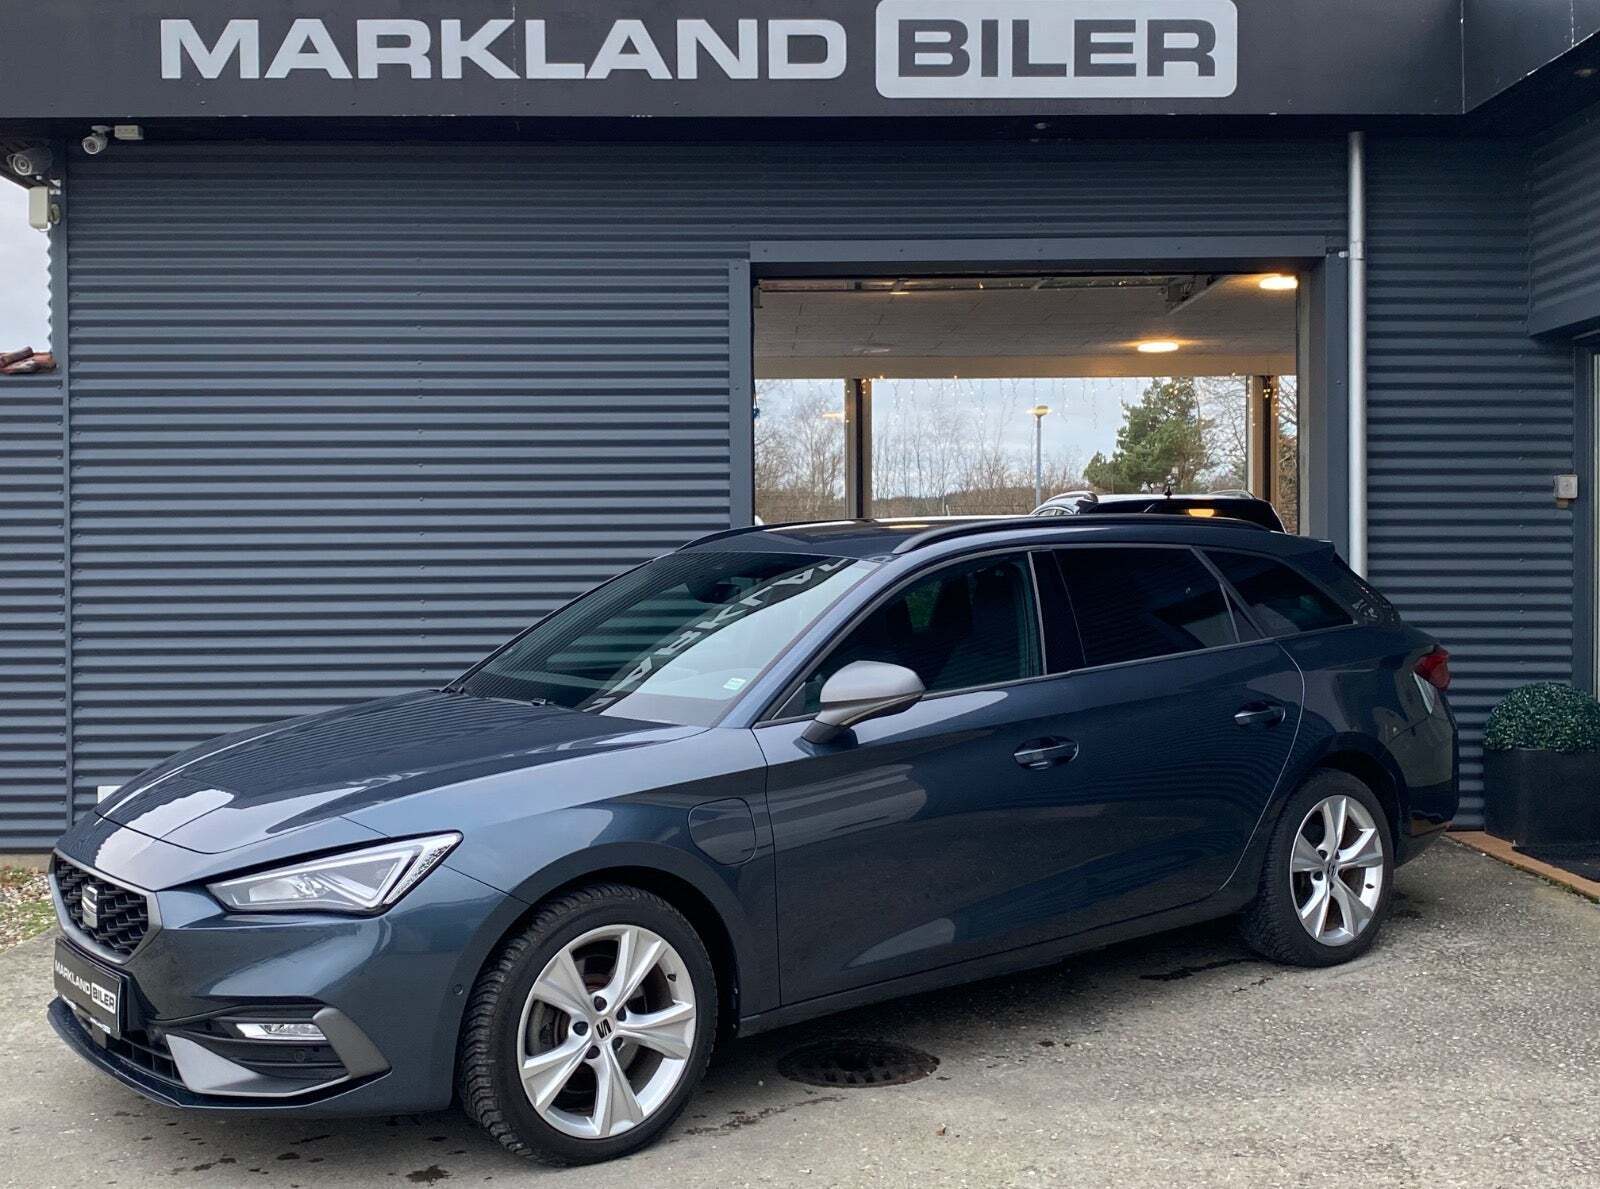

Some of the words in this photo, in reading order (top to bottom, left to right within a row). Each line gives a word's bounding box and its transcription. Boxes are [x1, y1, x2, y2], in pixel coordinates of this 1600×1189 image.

[160, 18, 847, 80] MARKLAND
[898, 19, 1216, 78] BILER
[55, 960, 91, 996] MARKLAND
[92, 984, 116, 1012] BILER
